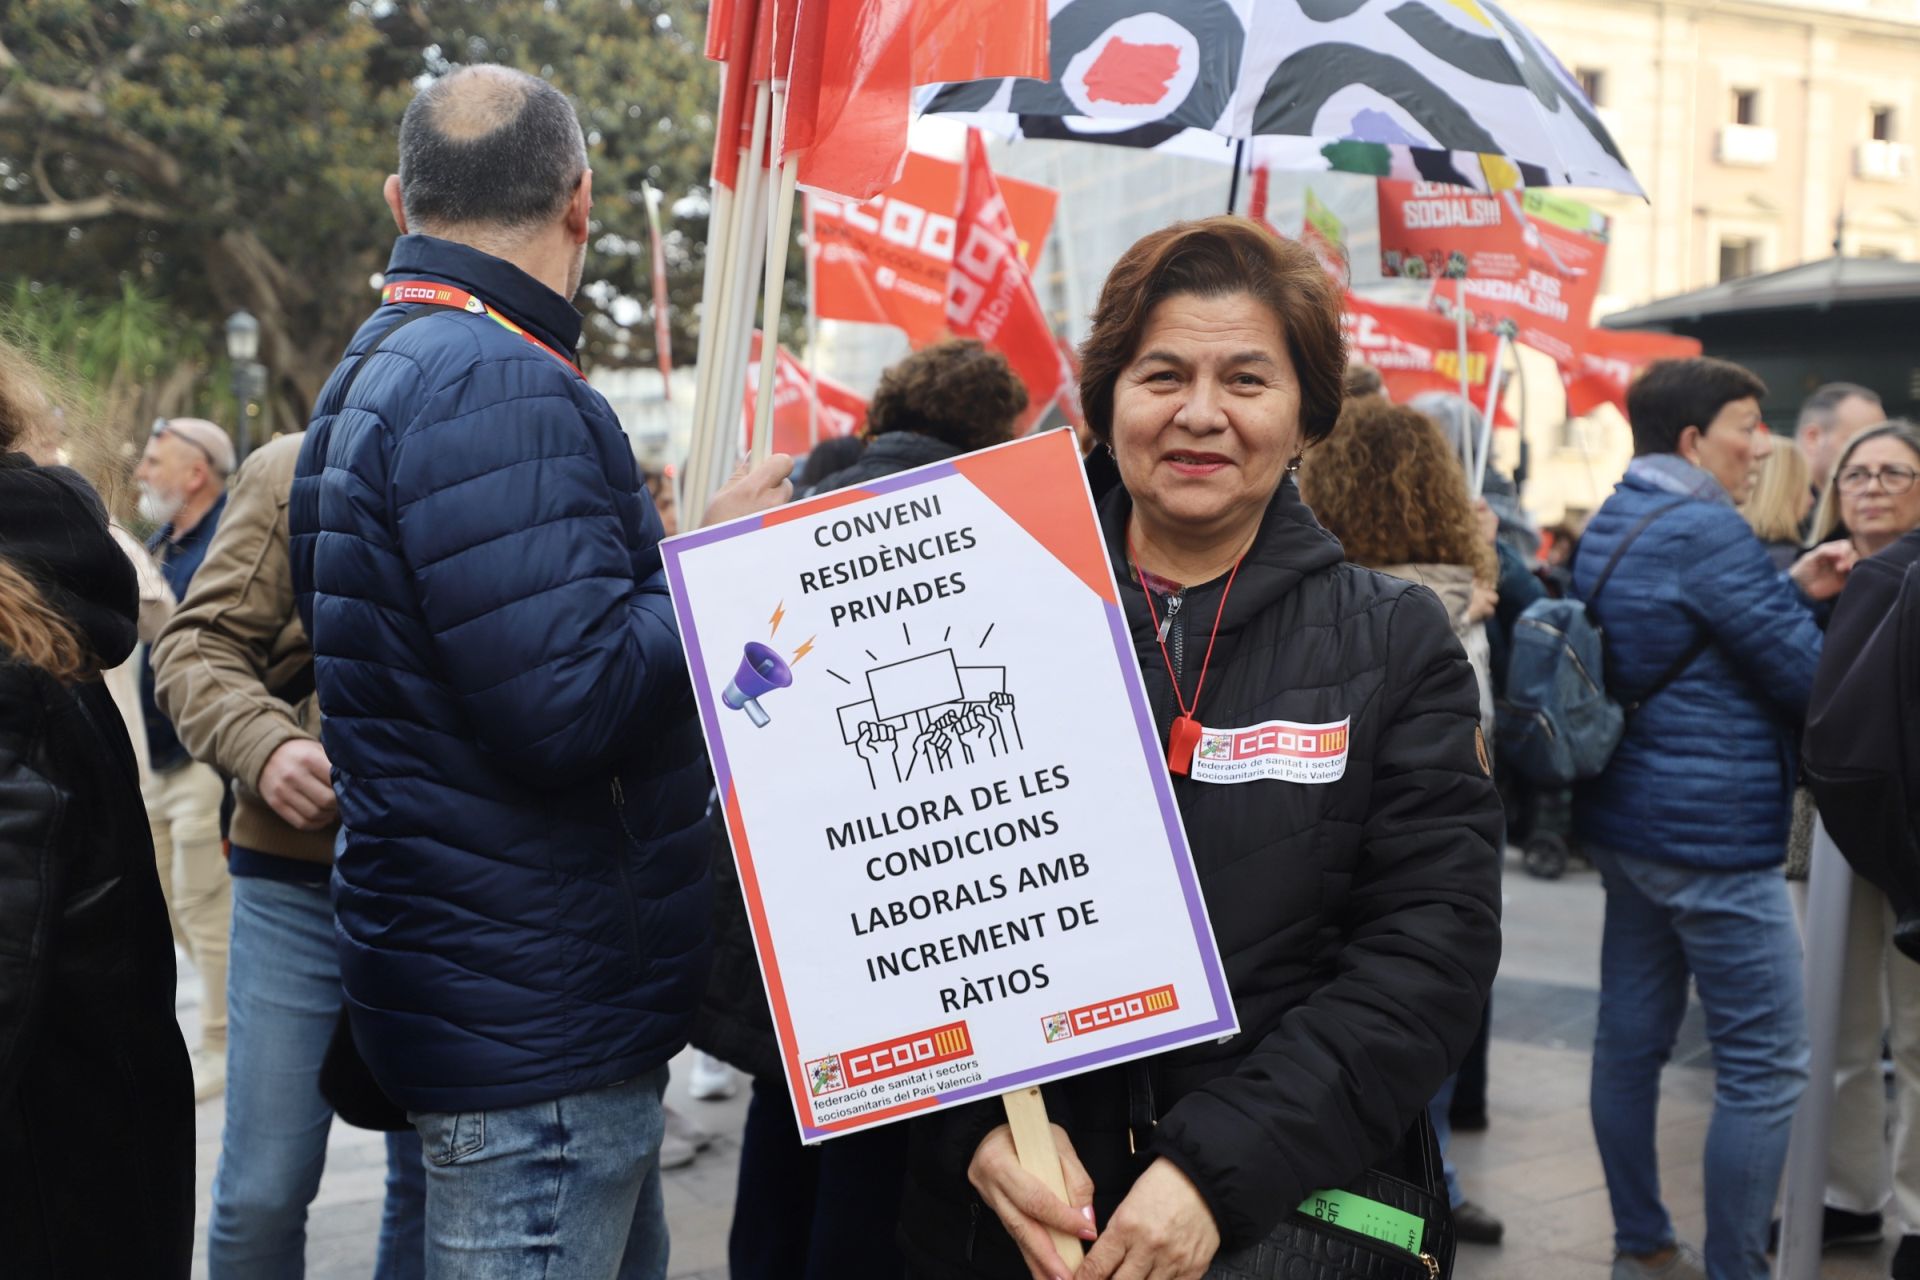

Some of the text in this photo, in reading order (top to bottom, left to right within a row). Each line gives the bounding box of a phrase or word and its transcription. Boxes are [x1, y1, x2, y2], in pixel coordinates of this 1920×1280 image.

[404, 287, 436, 299] CCOO
[815, 495, 942, 548] CONVENI
[799, 527, 976, 594] RESIDÈNCIES
[830, 571, 966, 628] PRIVADES
[1197, 760, 1247, 771] federació
[1250, 758, 1262, 768] de
[1265, 756, 1302, 768] sanitat
[1239, 731, 1317, 754] CCOO
[1196, 768, 1265, 781] sociosanitaris
[1267, 767, 1283, 777] del
[1285, 769, 1308, 780] País
[826, 765, 1070, 851] MILLORA DE LES
[866, 811, 1059, 882] CONDICIONS
[850, 853, 1090, 937] LABORALS AMB
[866, 900, 1099, 982] INCREMENT DE
[939, 964, 1050, 1014] RÀTIOS
[1074, 997, 1145, 1030] CCOO
[849, 1036, 936, 1078] CCOO
[813, 1089, 867, 1110] federació
[870, 1084, 885, 1095] de
[889, 1072, 927, 1090] sanitat
[935, 1060, 979, 1078] sectors
[817, 1073, 982, 1123] sociosanitaris del País Valencià
